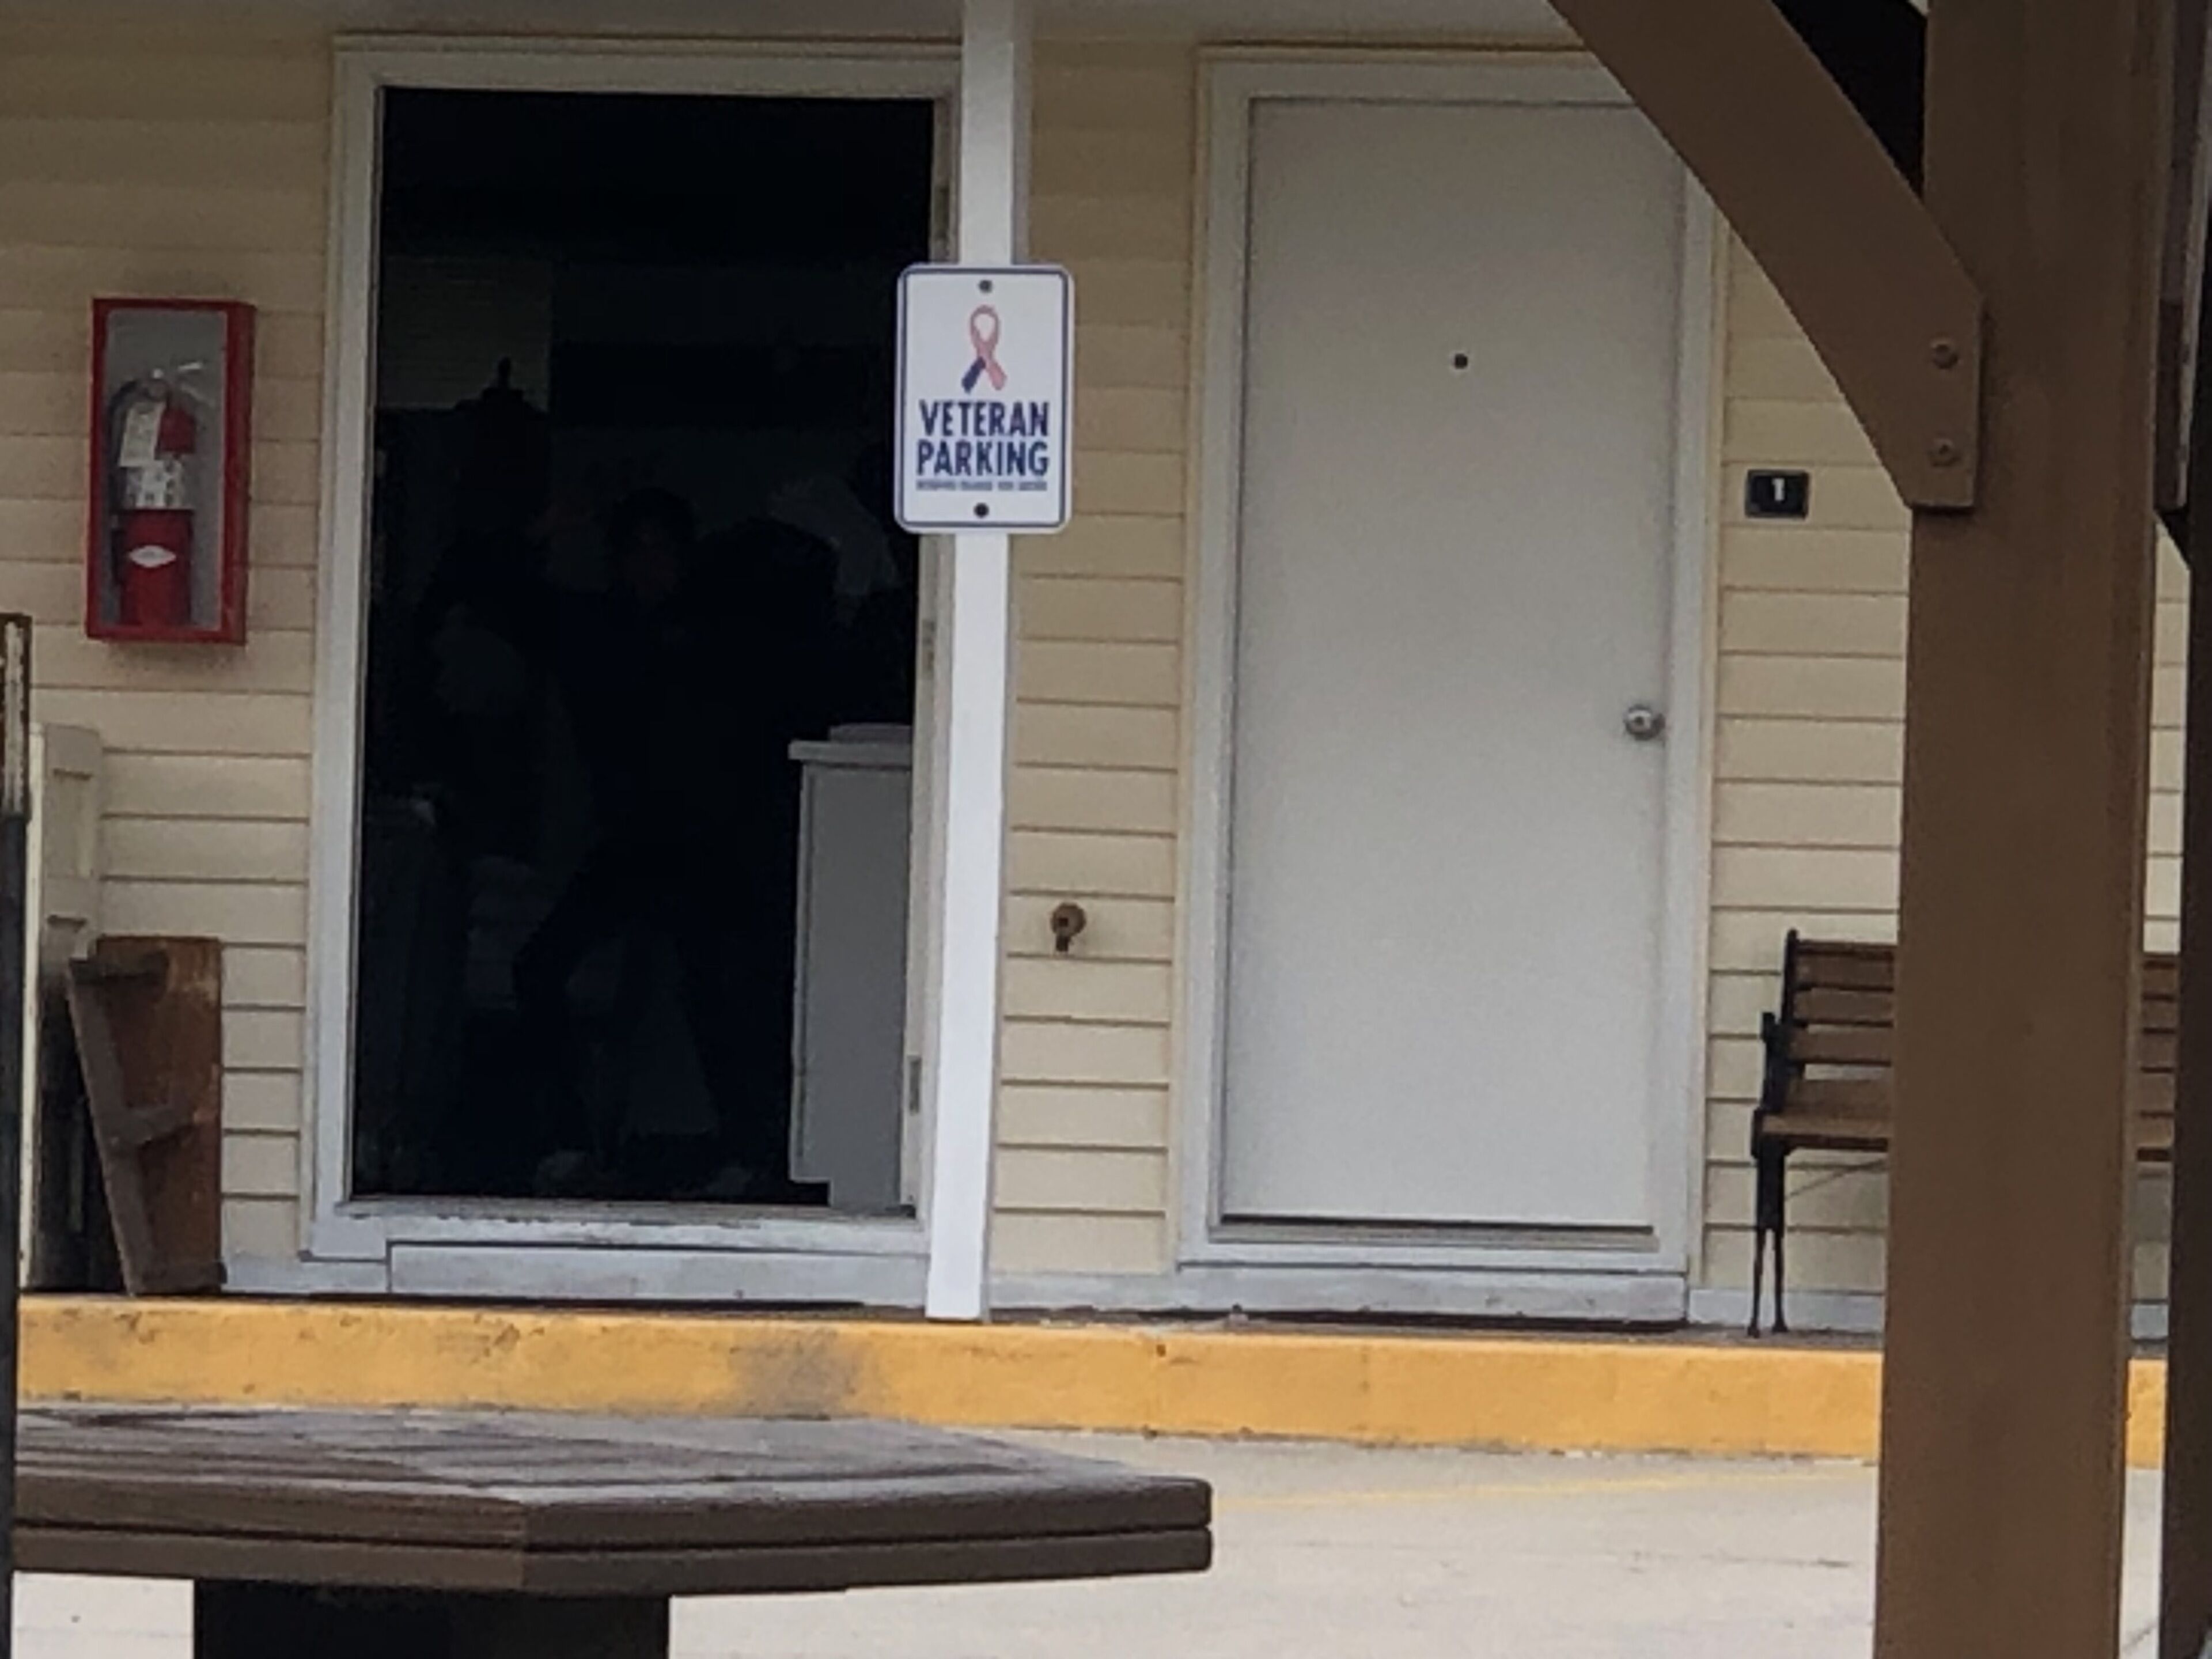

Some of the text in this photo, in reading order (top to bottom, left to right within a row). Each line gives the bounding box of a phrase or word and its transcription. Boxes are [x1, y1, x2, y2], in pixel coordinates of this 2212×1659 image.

[918, 400, 1049, 436] VETERAN
[916, 440, 1050, 477] PARKING
[1772, 478, 1785, 501] 1
